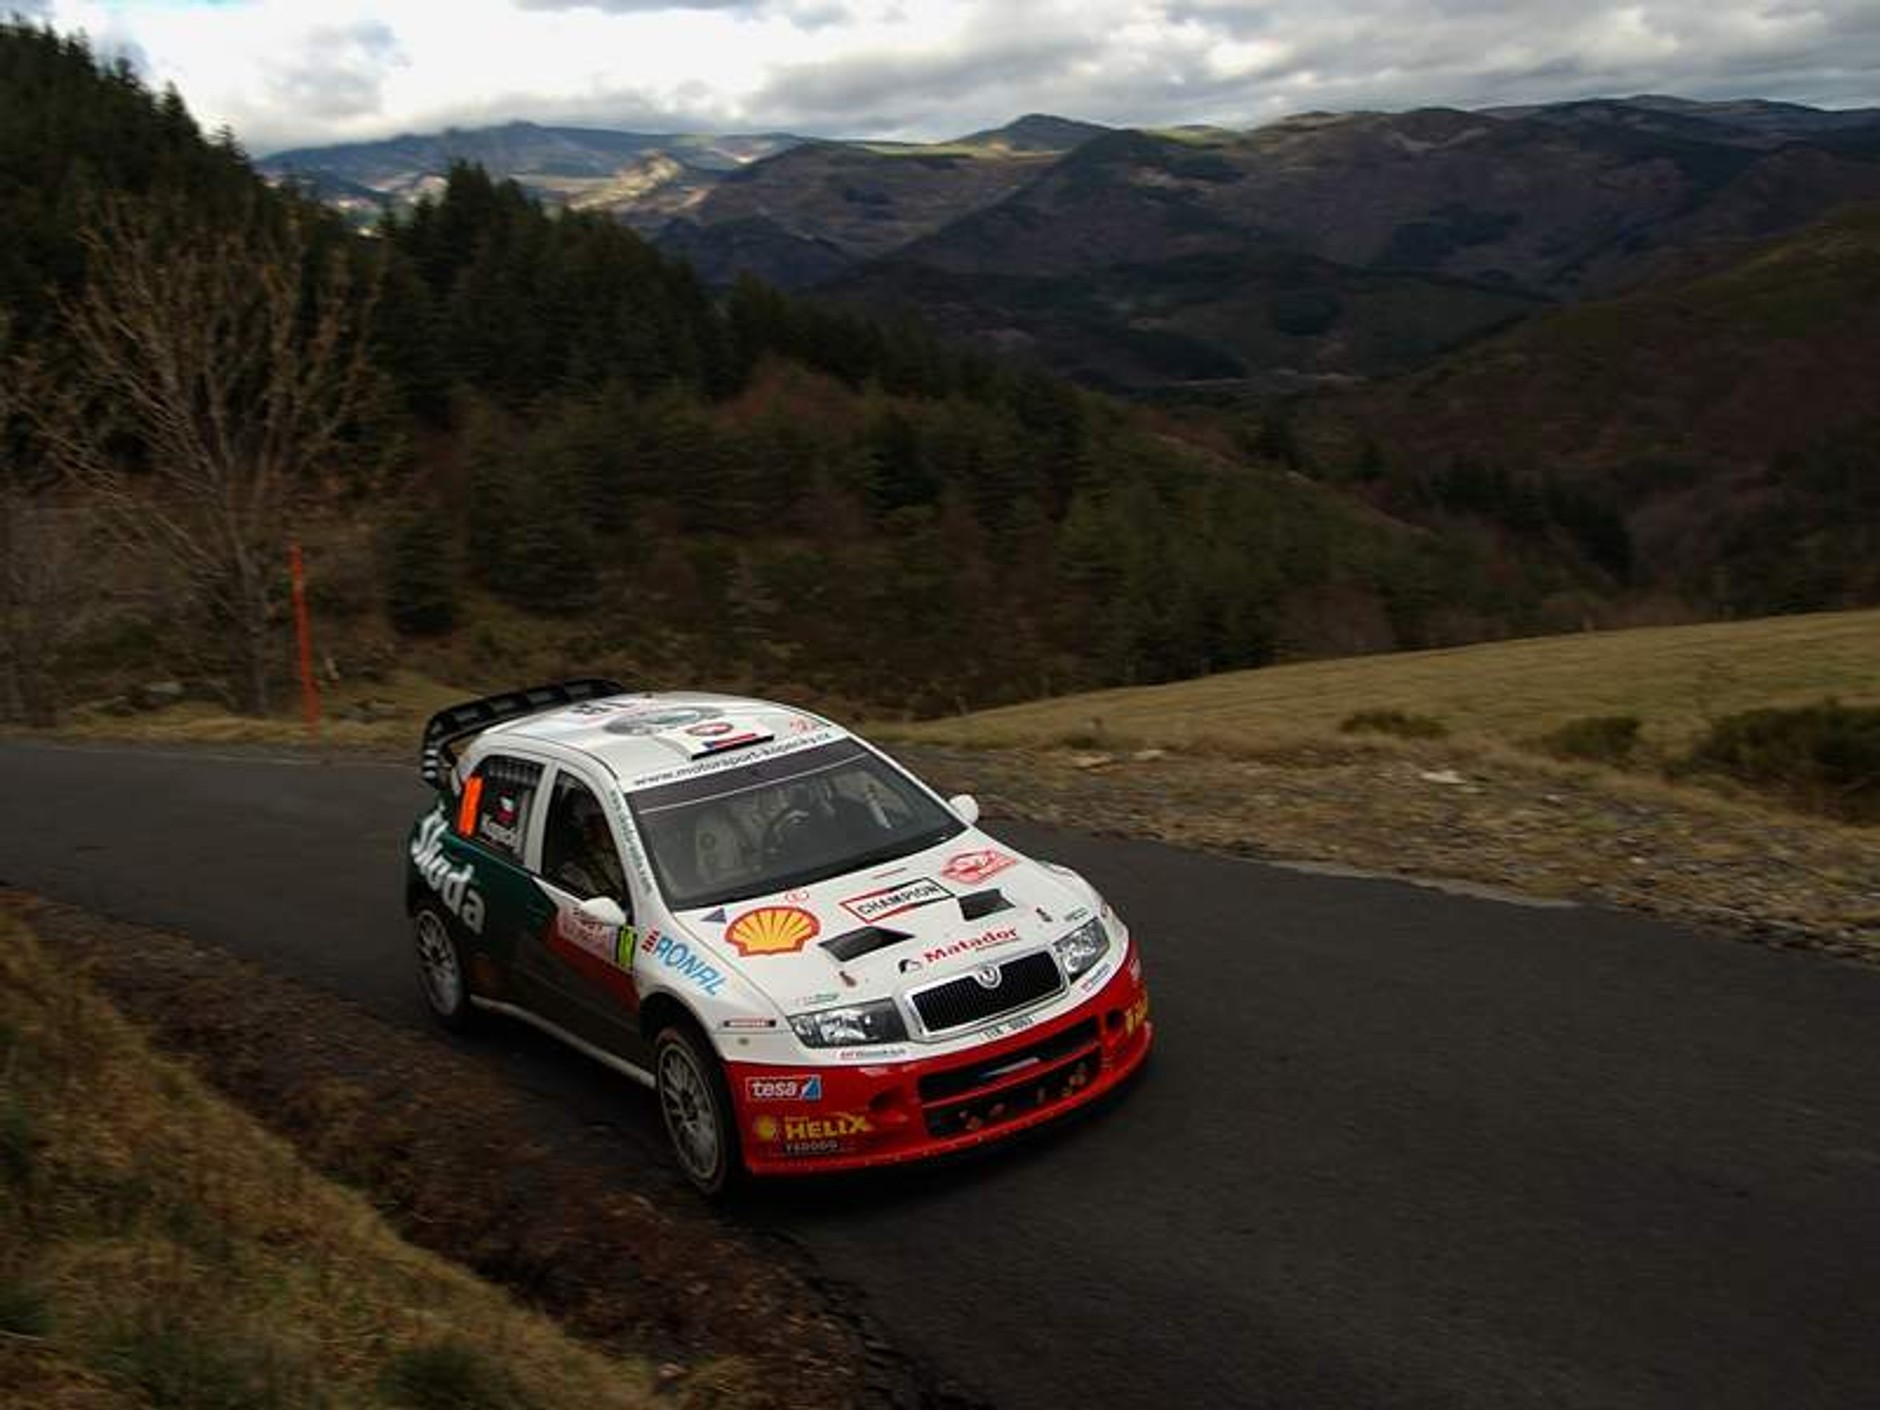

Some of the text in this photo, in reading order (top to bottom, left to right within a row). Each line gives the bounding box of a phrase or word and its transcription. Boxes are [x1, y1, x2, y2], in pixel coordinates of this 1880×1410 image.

[856, 882, 940, 916] CHAMPION
[923, 928, 1018, 963] Matador
[653, 935, 728, 996] RONAL
[751, 1080, 798, 1098] tesa
[785, 1113, 873, 1140] HELIX
